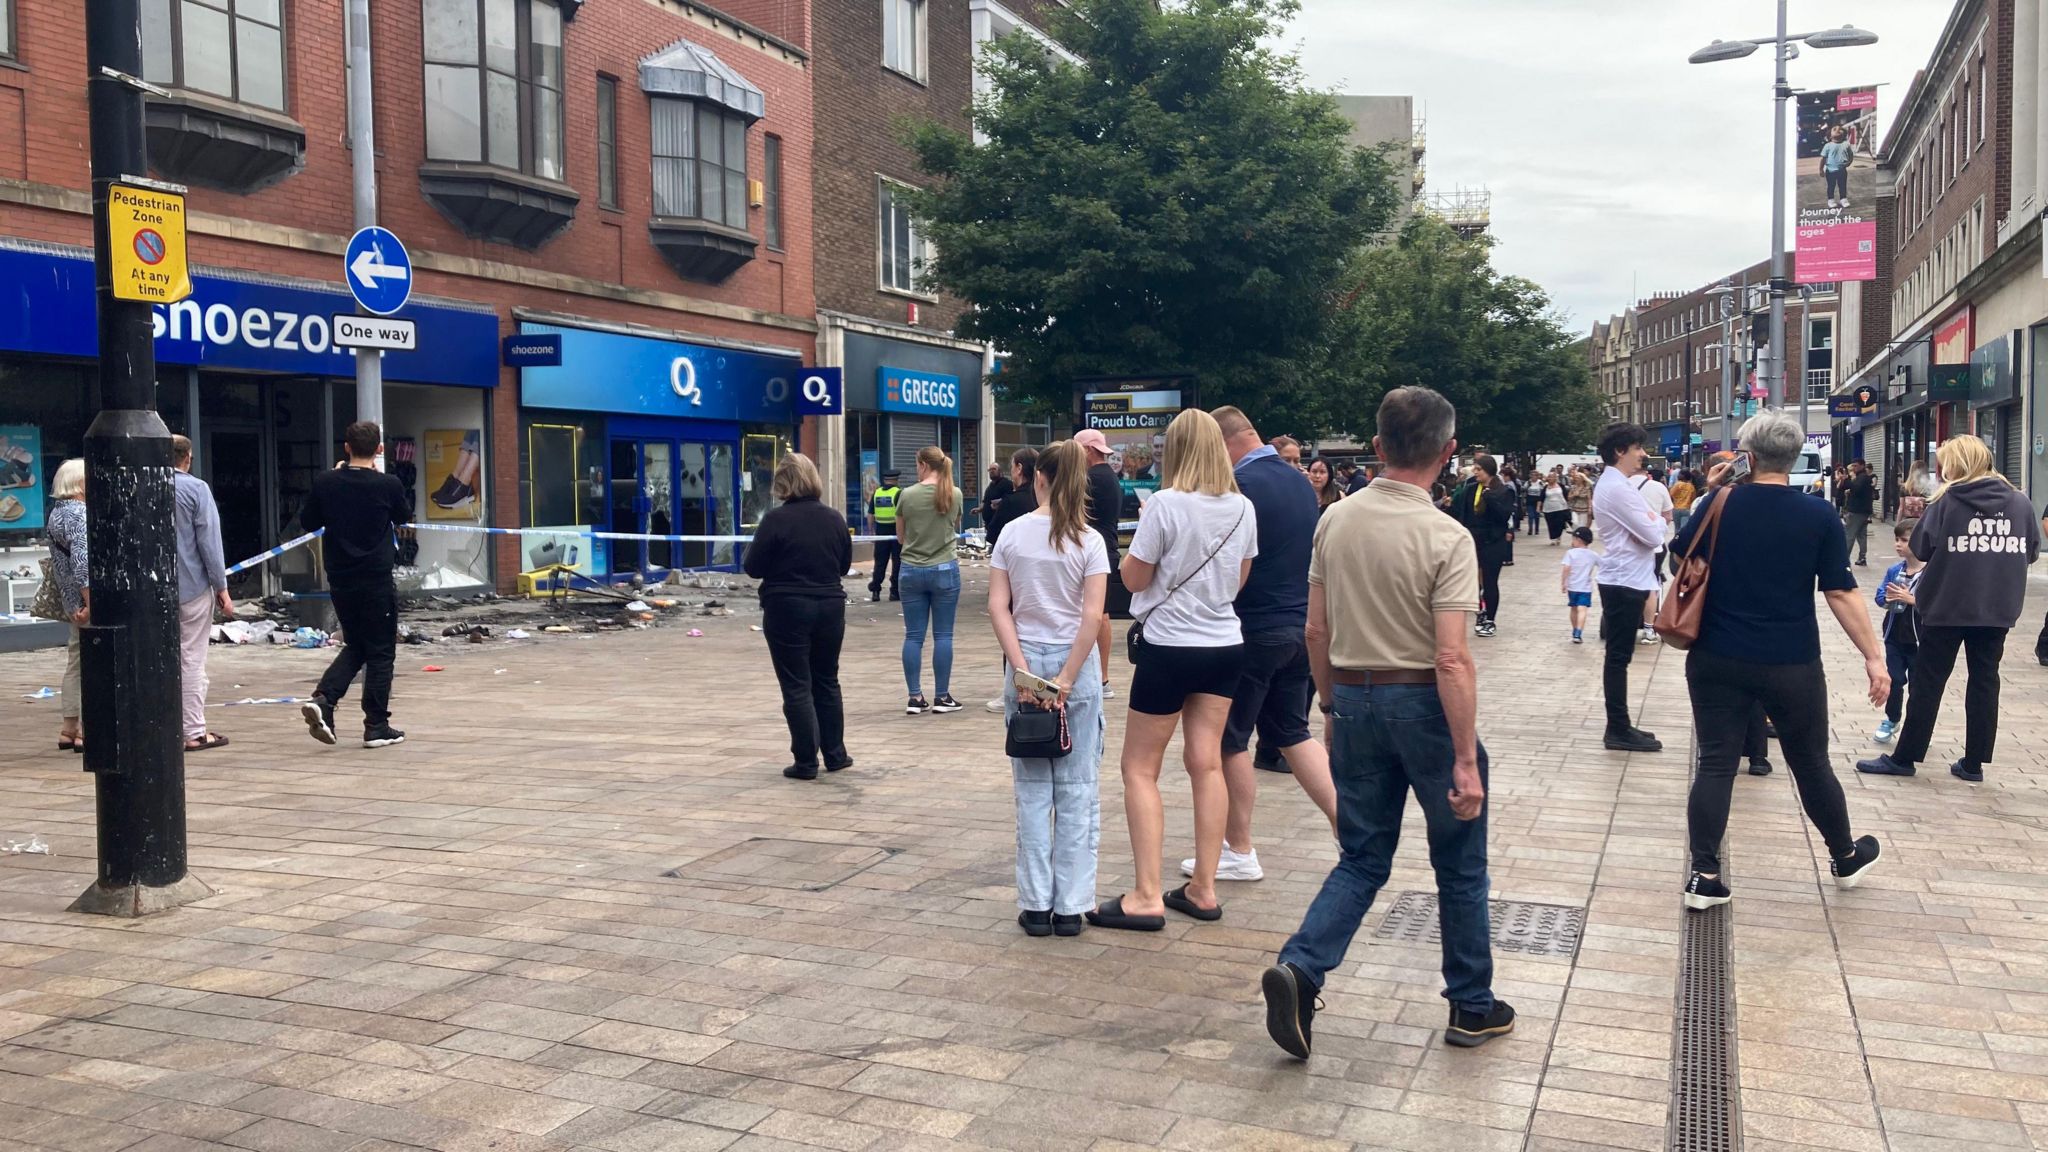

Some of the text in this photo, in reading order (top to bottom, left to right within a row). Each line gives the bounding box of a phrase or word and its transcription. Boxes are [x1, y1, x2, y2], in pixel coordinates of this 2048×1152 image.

[113, 192, 180, 213] Pedestrian
[132, 209, 163, 225] Zone
[1800, 207, 1842, 217] Journey
[1800, 214, 1861, 227] through the
[1800, 228, 1825, 238] ages
[131, 268, 170, 285] At any
[138, 284, 165, 297] time
[341, 322, 409, 343] One way
[511, 345, 554, 355] shoezone
[670, 356, 702, 406] O2
[803, 376, 832, 406] O2
[902, 377, 956, 408] GREGGS
[1091, 402, 1117, 412] Are you
[1091, 416, 1123, 428] Proud
[1126, 415, 1137, 427] to
[1968, 518, 2011, 536] ATH
[1947, 535, 2027, 554] LEISURE
